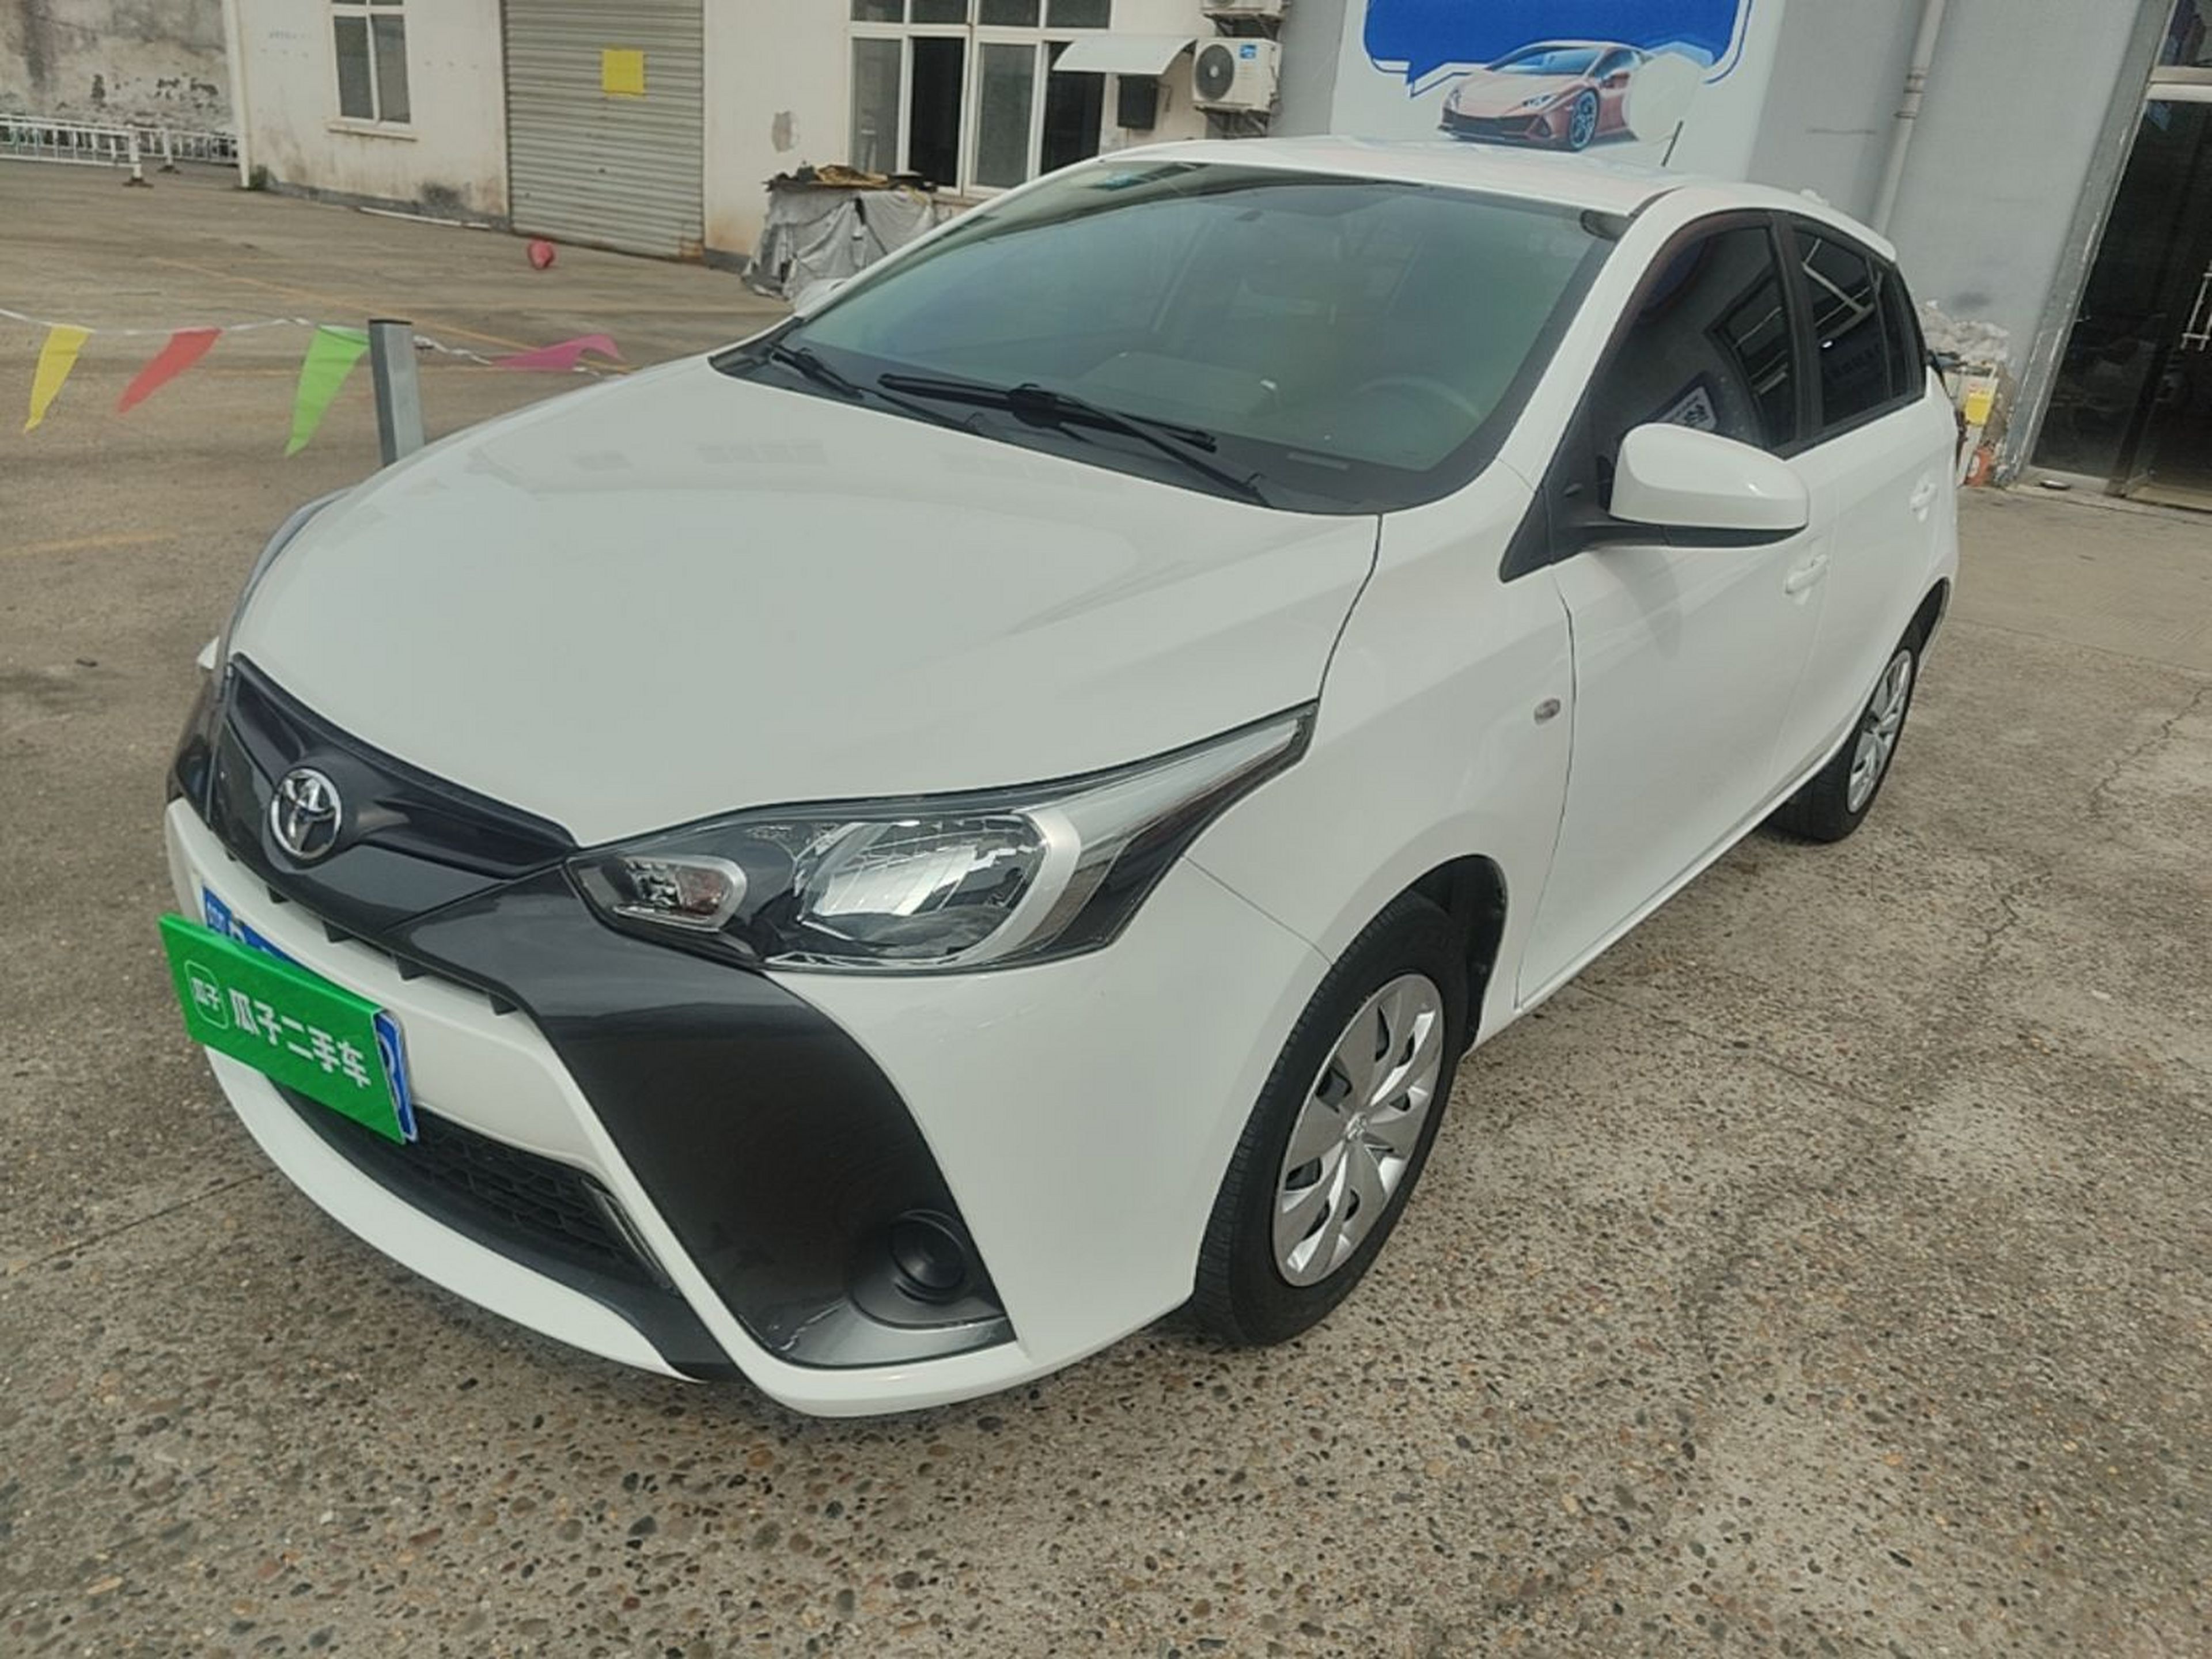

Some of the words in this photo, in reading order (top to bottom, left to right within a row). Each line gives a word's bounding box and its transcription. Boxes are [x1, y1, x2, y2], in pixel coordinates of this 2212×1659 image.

[228, 987, 372, 1089] 瓜子二手车
